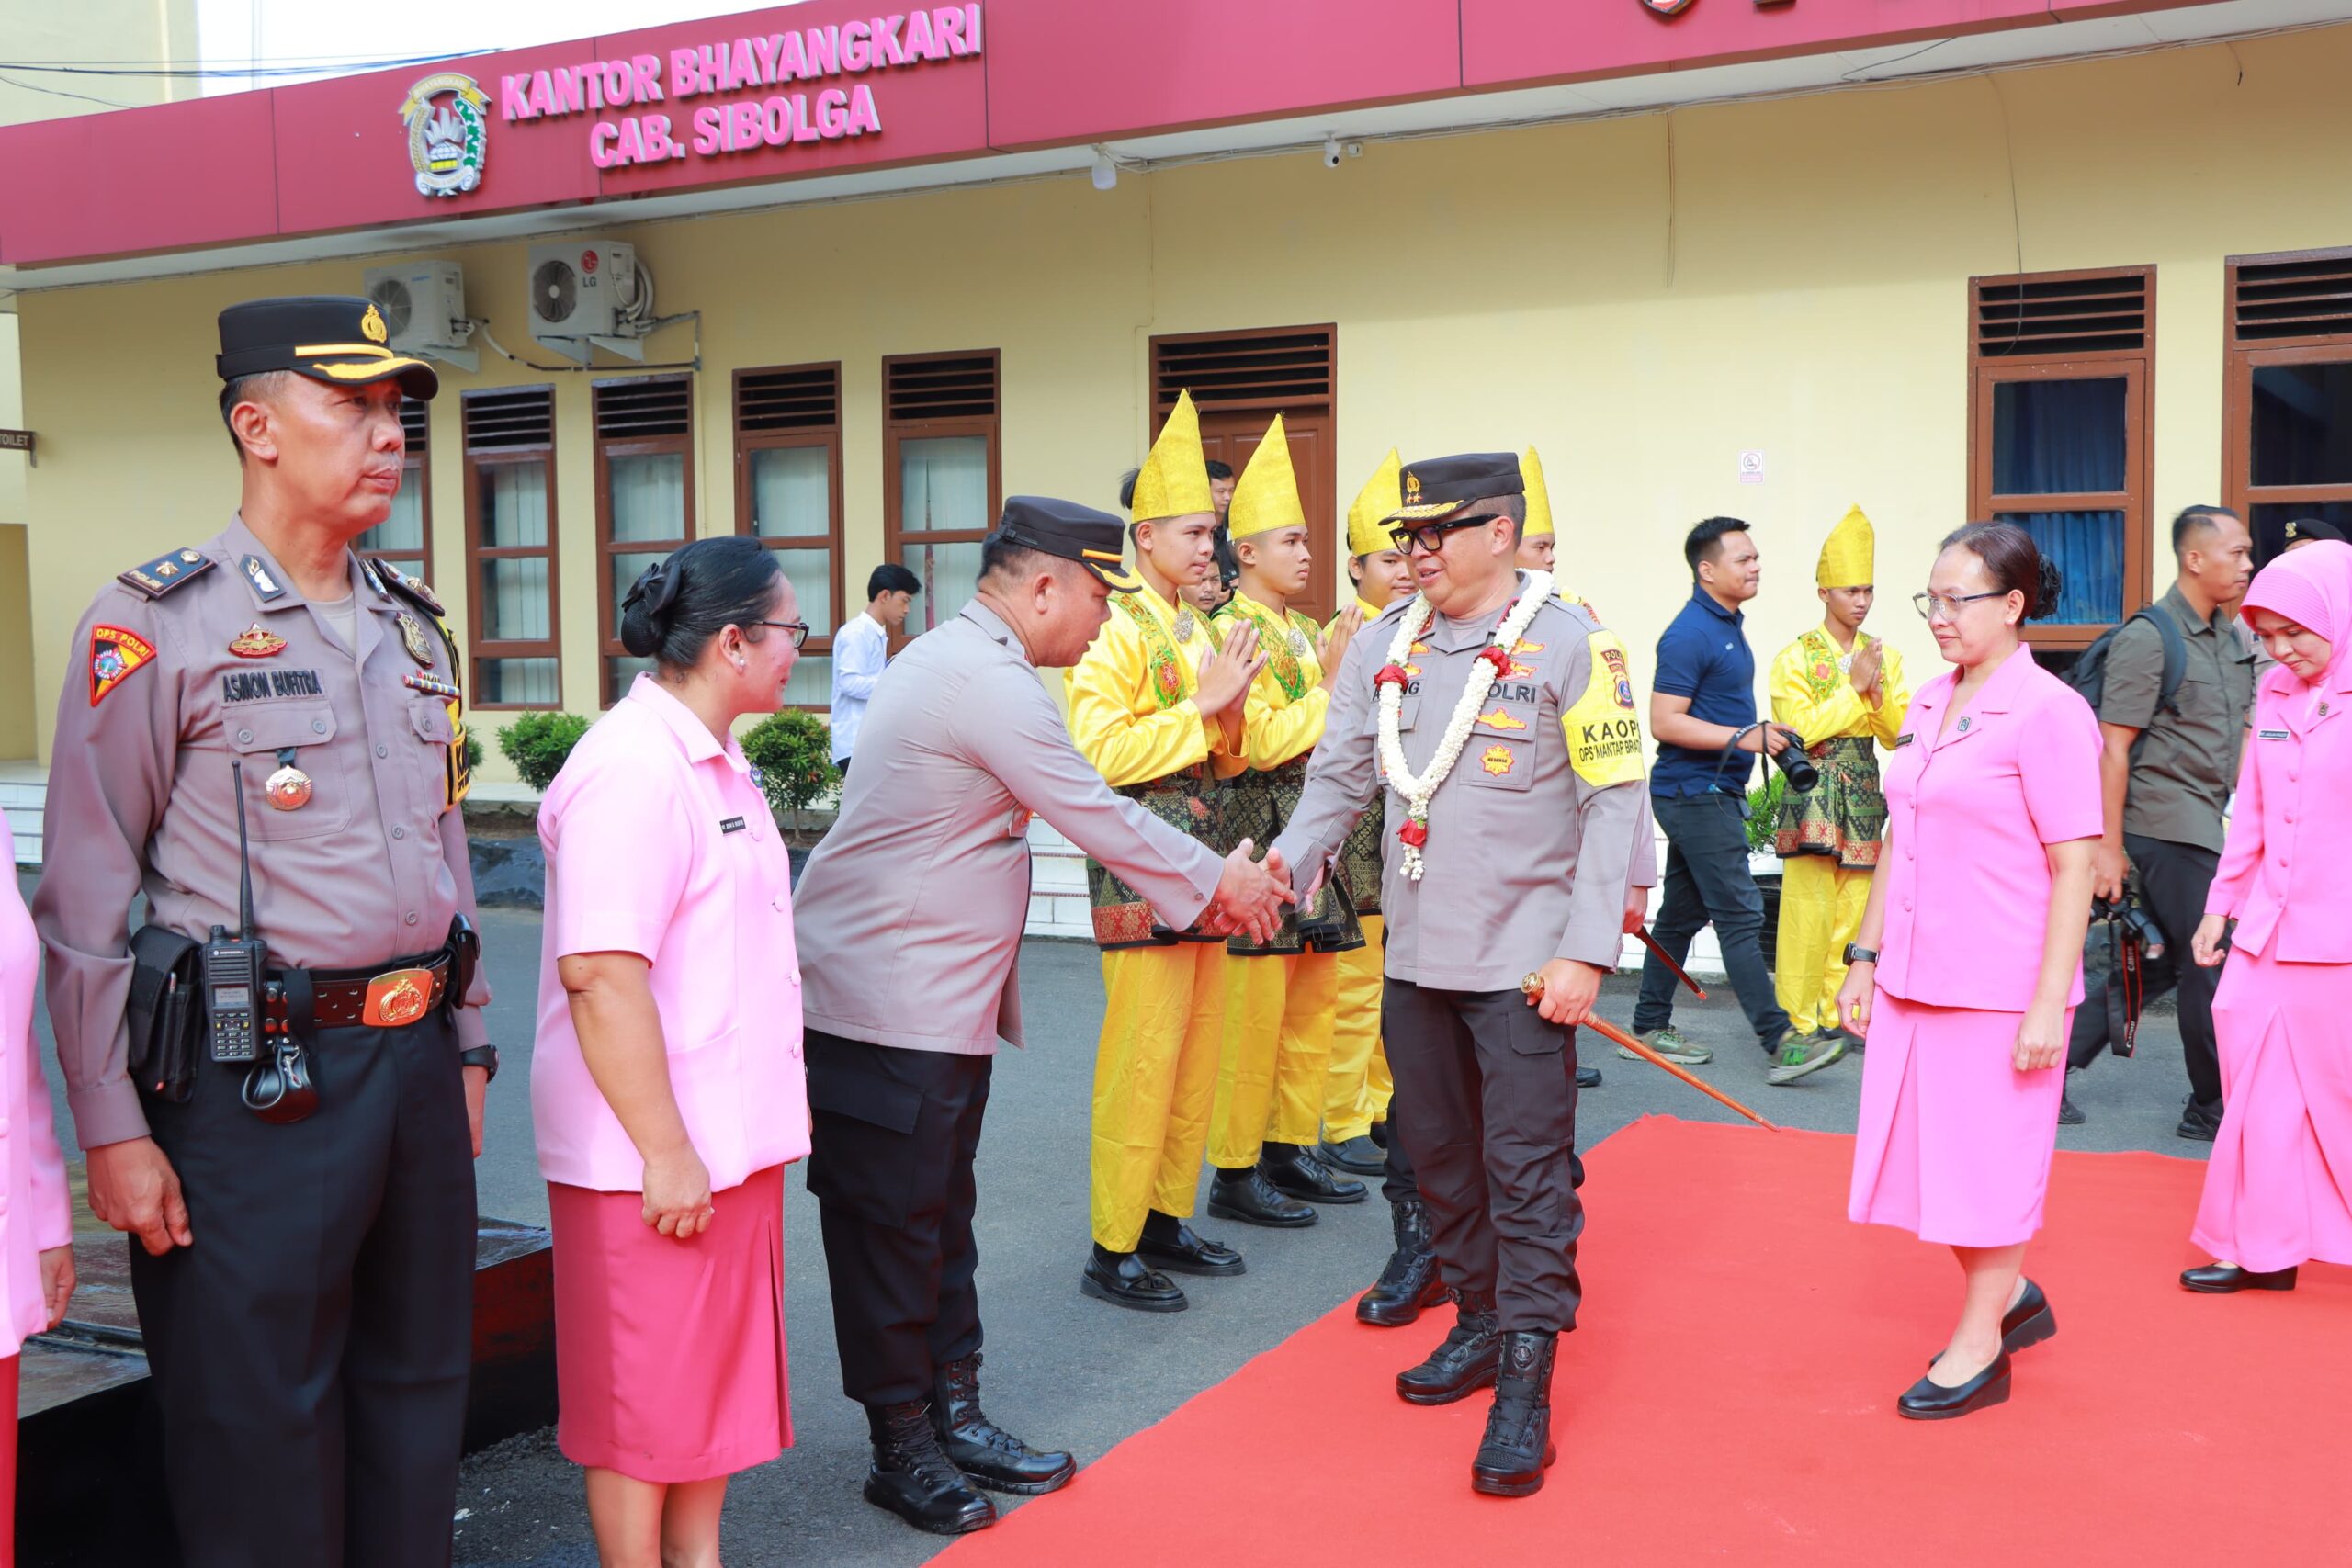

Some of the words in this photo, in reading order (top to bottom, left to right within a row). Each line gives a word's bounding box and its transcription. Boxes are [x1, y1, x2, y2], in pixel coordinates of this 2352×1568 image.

[500, 54, 662, 121] KANTOR
[671, 1, 983, 97] BHAYANGKARI
[590, 114, 685, 168] CAB.
[693, 84, 882, 155] SIBOLGA
[582, 276, 597, 288] LG
[96, 627, 117, 640] OPS
[119, 632, 151, 657] POLRI
[223, 671, 272, 703] ASMON
[1487, 682, 1536, 704] OLRI
[1578, 745, 1594, 762] OPS
[2127, 945, 2136, 972] Canon
[2125, 1021, 2136, 1049] Canon
